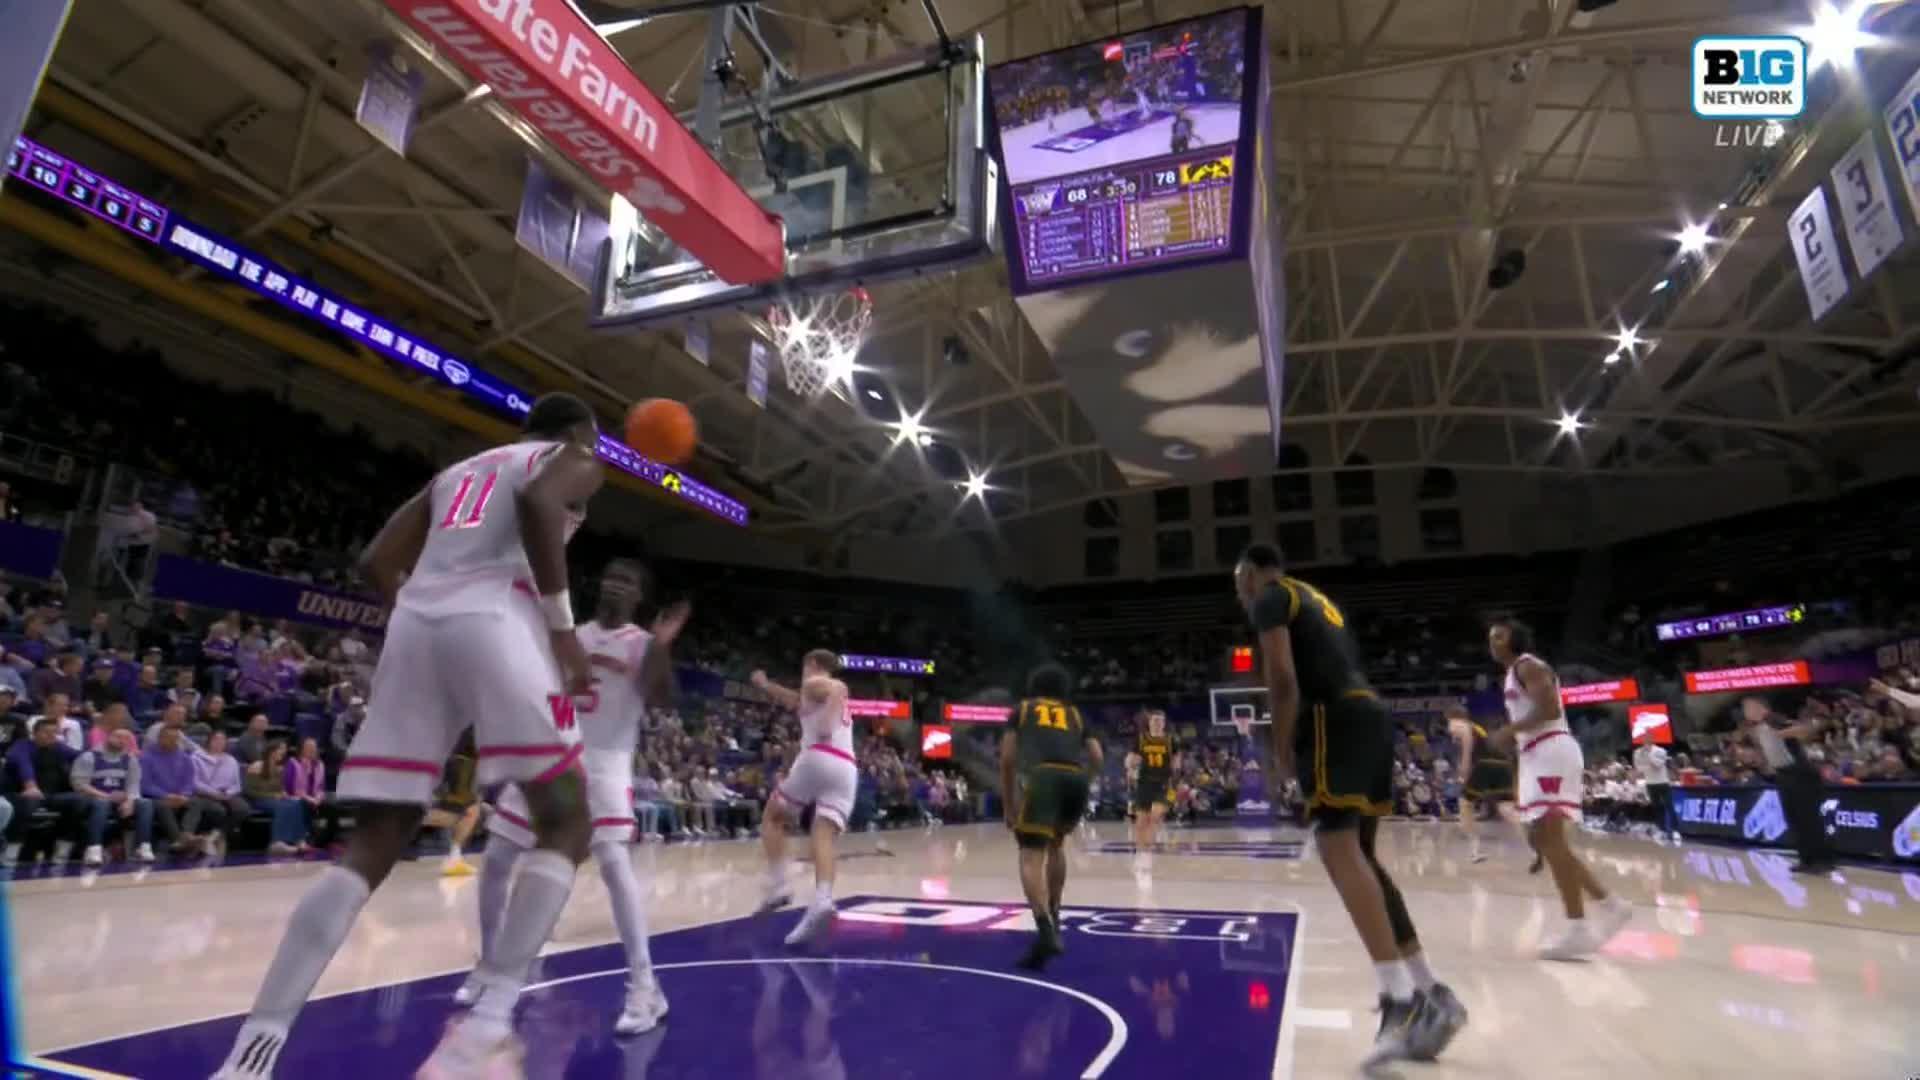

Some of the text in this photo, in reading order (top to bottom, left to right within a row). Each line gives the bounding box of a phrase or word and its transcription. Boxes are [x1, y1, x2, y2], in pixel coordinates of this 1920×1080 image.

[412, 5, 641, 178] State Farm
[559, 33, 660, 152] Farm
[32, 164, 58, 187] 10
[71, 183, 86, 200] 3
[1155, 171, 1176, 185] 78
[1847, 159, 1873, 214] 3
[105, 200, 120, 217] 0
[1067, 188, 1087, 203] 68
[1800, 212, 1822, 262] 2
[437, 470, 499, 529] 11
